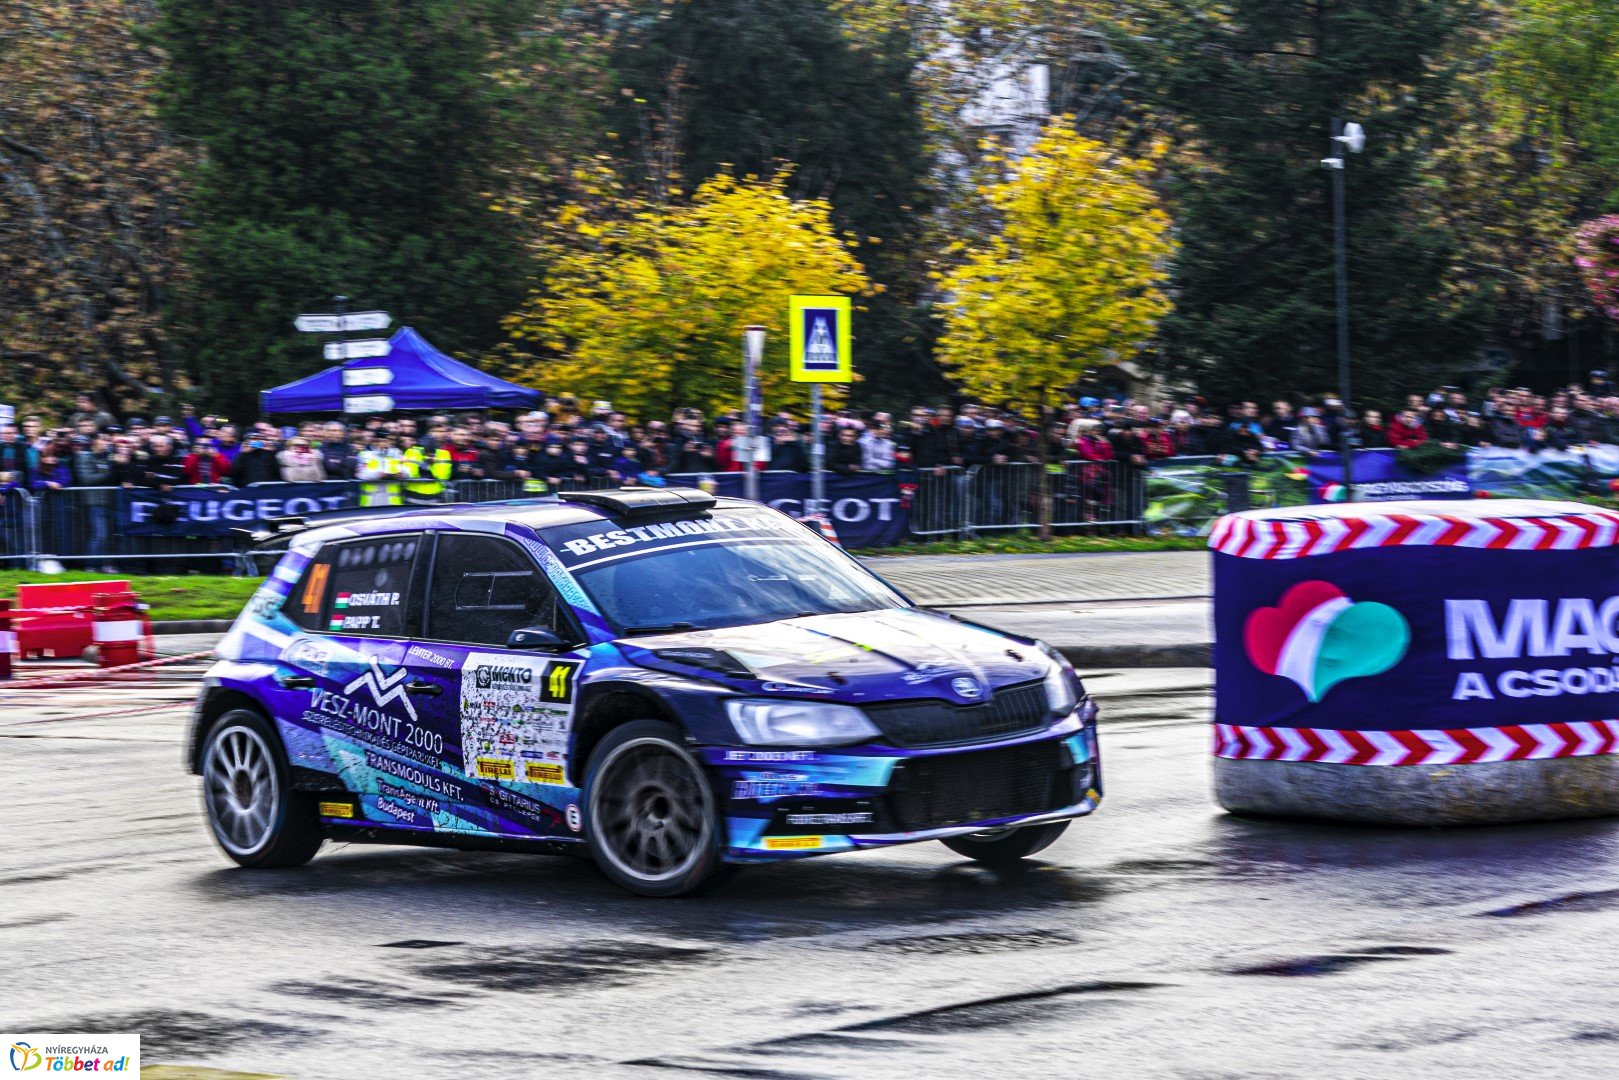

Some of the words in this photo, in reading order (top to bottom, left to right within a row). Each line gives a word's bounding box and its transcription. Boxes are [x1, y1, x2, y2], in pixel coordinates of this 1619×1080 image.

[349, 590, 391, 606] OSVÁTH
[343, 616, 372, 628] PAPP
[429, 653, 446, 666] 2000
[549, 665, 571, 698] 41
[1451, 672, 1495, 700] A
[1497, 658, 1619, 697] CSOD
[310, 687, 402, 738] VESZ-MONT
[405, 723, 443, 755] 2000
[367, 751, 441, 793] TRANSMODULS
[442, 779, 464, 802] KFT.
[479, 761, 512, 776] PIRELLI
[528, 766, 564, 781] PIRELLI
[377, 780, 426, 808] TransAgent
[425, 798, 441, 814] Kft.
[377, 797, 415, 823] Budapest
